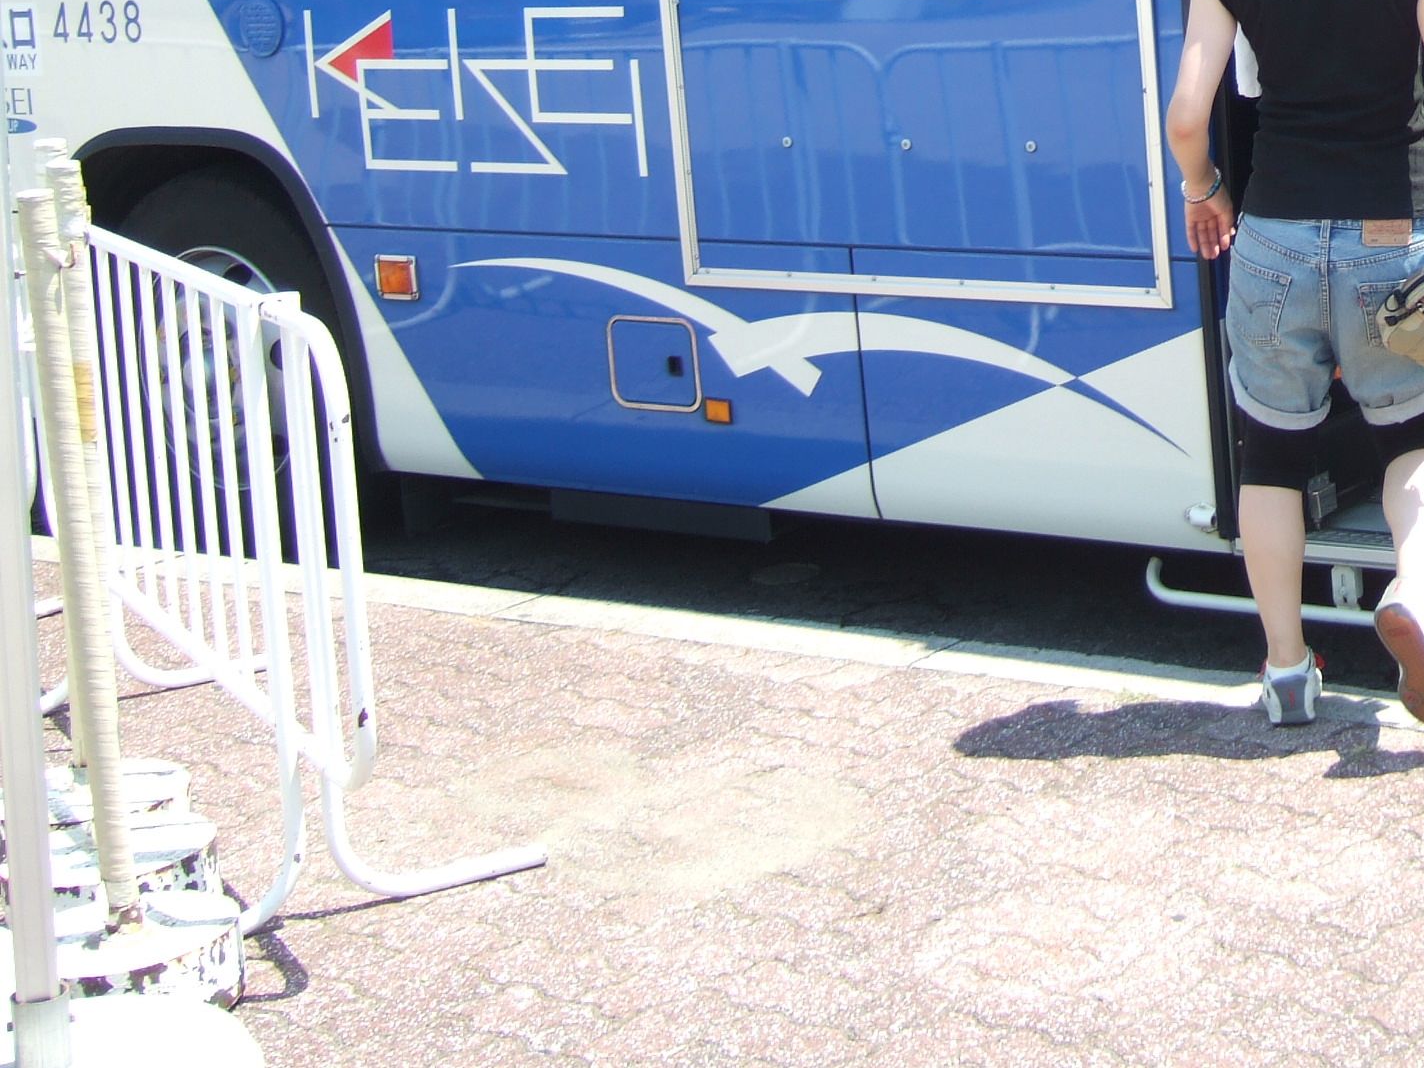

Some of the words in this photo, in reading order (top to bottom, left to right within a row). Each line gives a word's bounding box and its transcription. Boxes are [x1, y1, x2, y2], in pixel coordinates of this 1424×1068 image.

[2, 8, 36, 50] 口
[53, 0, 142, 44] 4438
[7, 53, 38, 71] WAY
